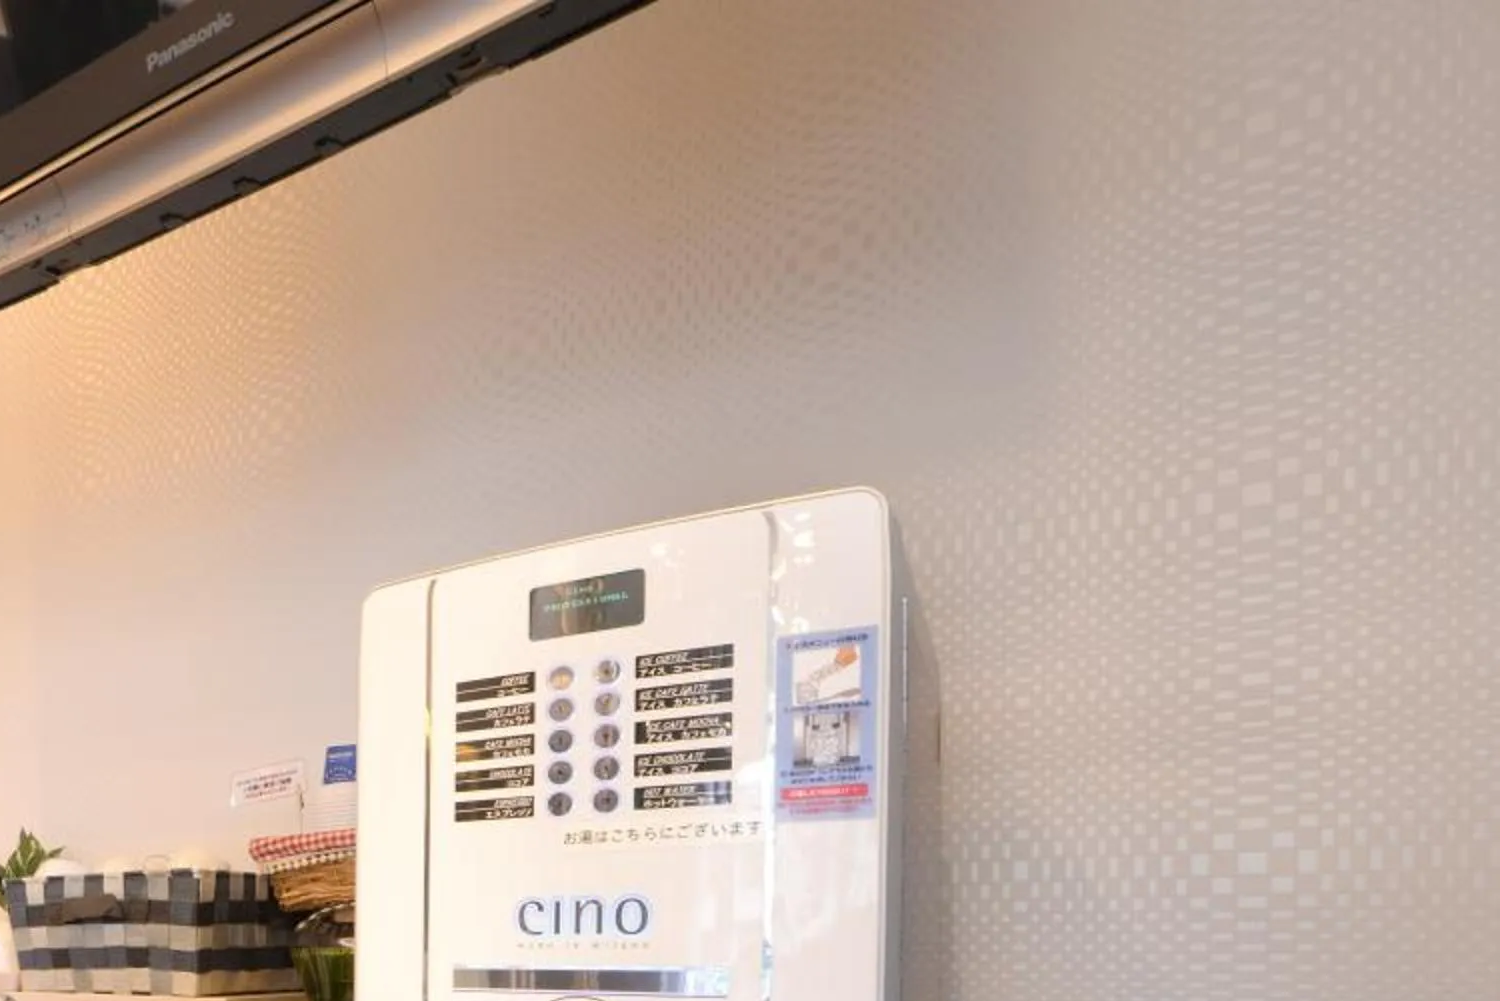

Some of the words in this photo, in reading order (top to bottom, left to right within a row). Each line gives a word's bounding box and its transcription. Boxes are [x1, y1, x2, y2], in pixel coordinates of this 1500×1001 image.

[146, 12, 235, 74] Panasonic
[564, 821, 761, 845] お湯はこちらにございます
[518, 897, 649, 935] cino
